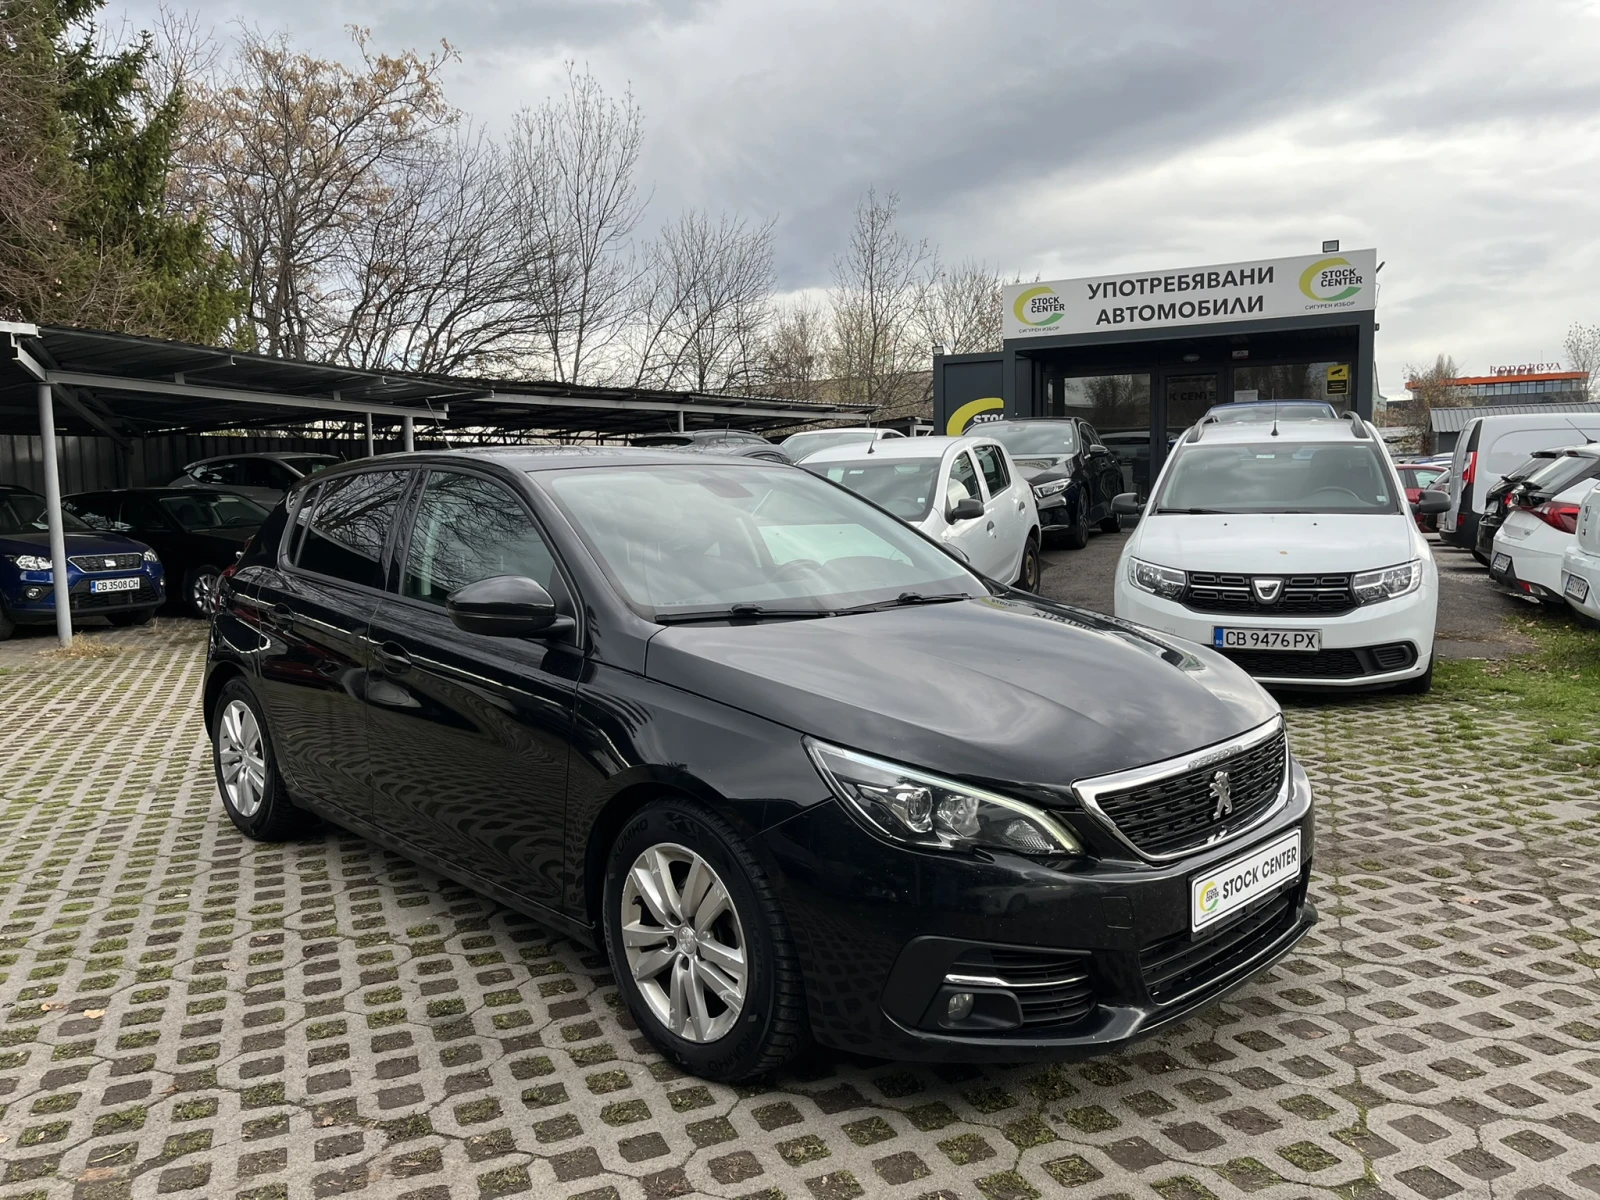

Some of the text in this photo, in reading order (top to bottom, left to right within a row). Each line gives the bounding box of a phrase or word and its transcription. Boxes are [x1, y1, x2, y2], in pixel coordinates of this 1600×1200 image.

[1321, 268, 1357, 279] STOCK
[1087, 265, 1275, 300] УПОТРЕБЯВАНИ
[1320, 276, 1363, 287] CENTER
[1031, 296, 1060, 306] STOCK
[1305, 302, 1333, 310] СИГУРЕН
[1031, 303, 1065, 313] CENTER
[1095, 295, 1264, 326] АВТОМОБИЛИ
[96, 579, 139, 591] CB 3508 CH
[1225, 631, 1316, 648] CB 9476 PX
[613, 818, 648, 862] KUMHO
[1222, 846, 1297, 900] STOCK CENTER
